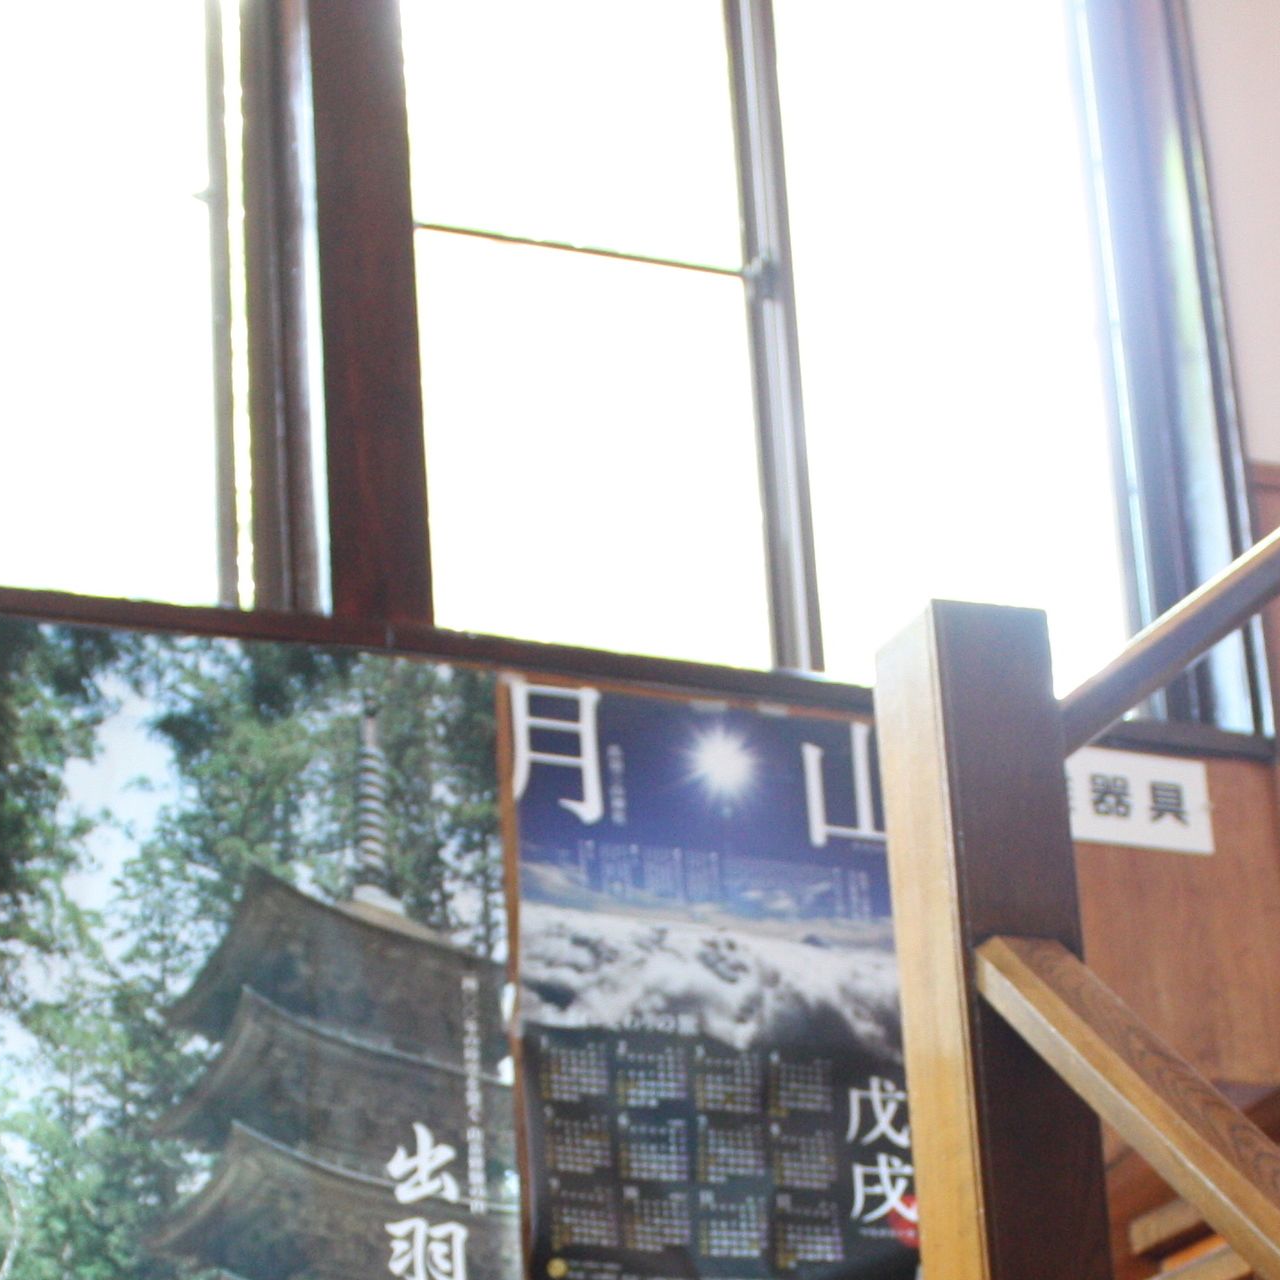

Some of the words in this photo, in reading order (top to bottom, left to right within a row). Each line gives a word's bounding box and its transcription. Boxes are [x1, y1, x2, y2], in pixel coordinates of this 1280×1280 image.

[509, 680, 604, 824] 月
[1068, 772, 1189, 828] 器具
[846, 1076, 919, 1224] 戊戌
